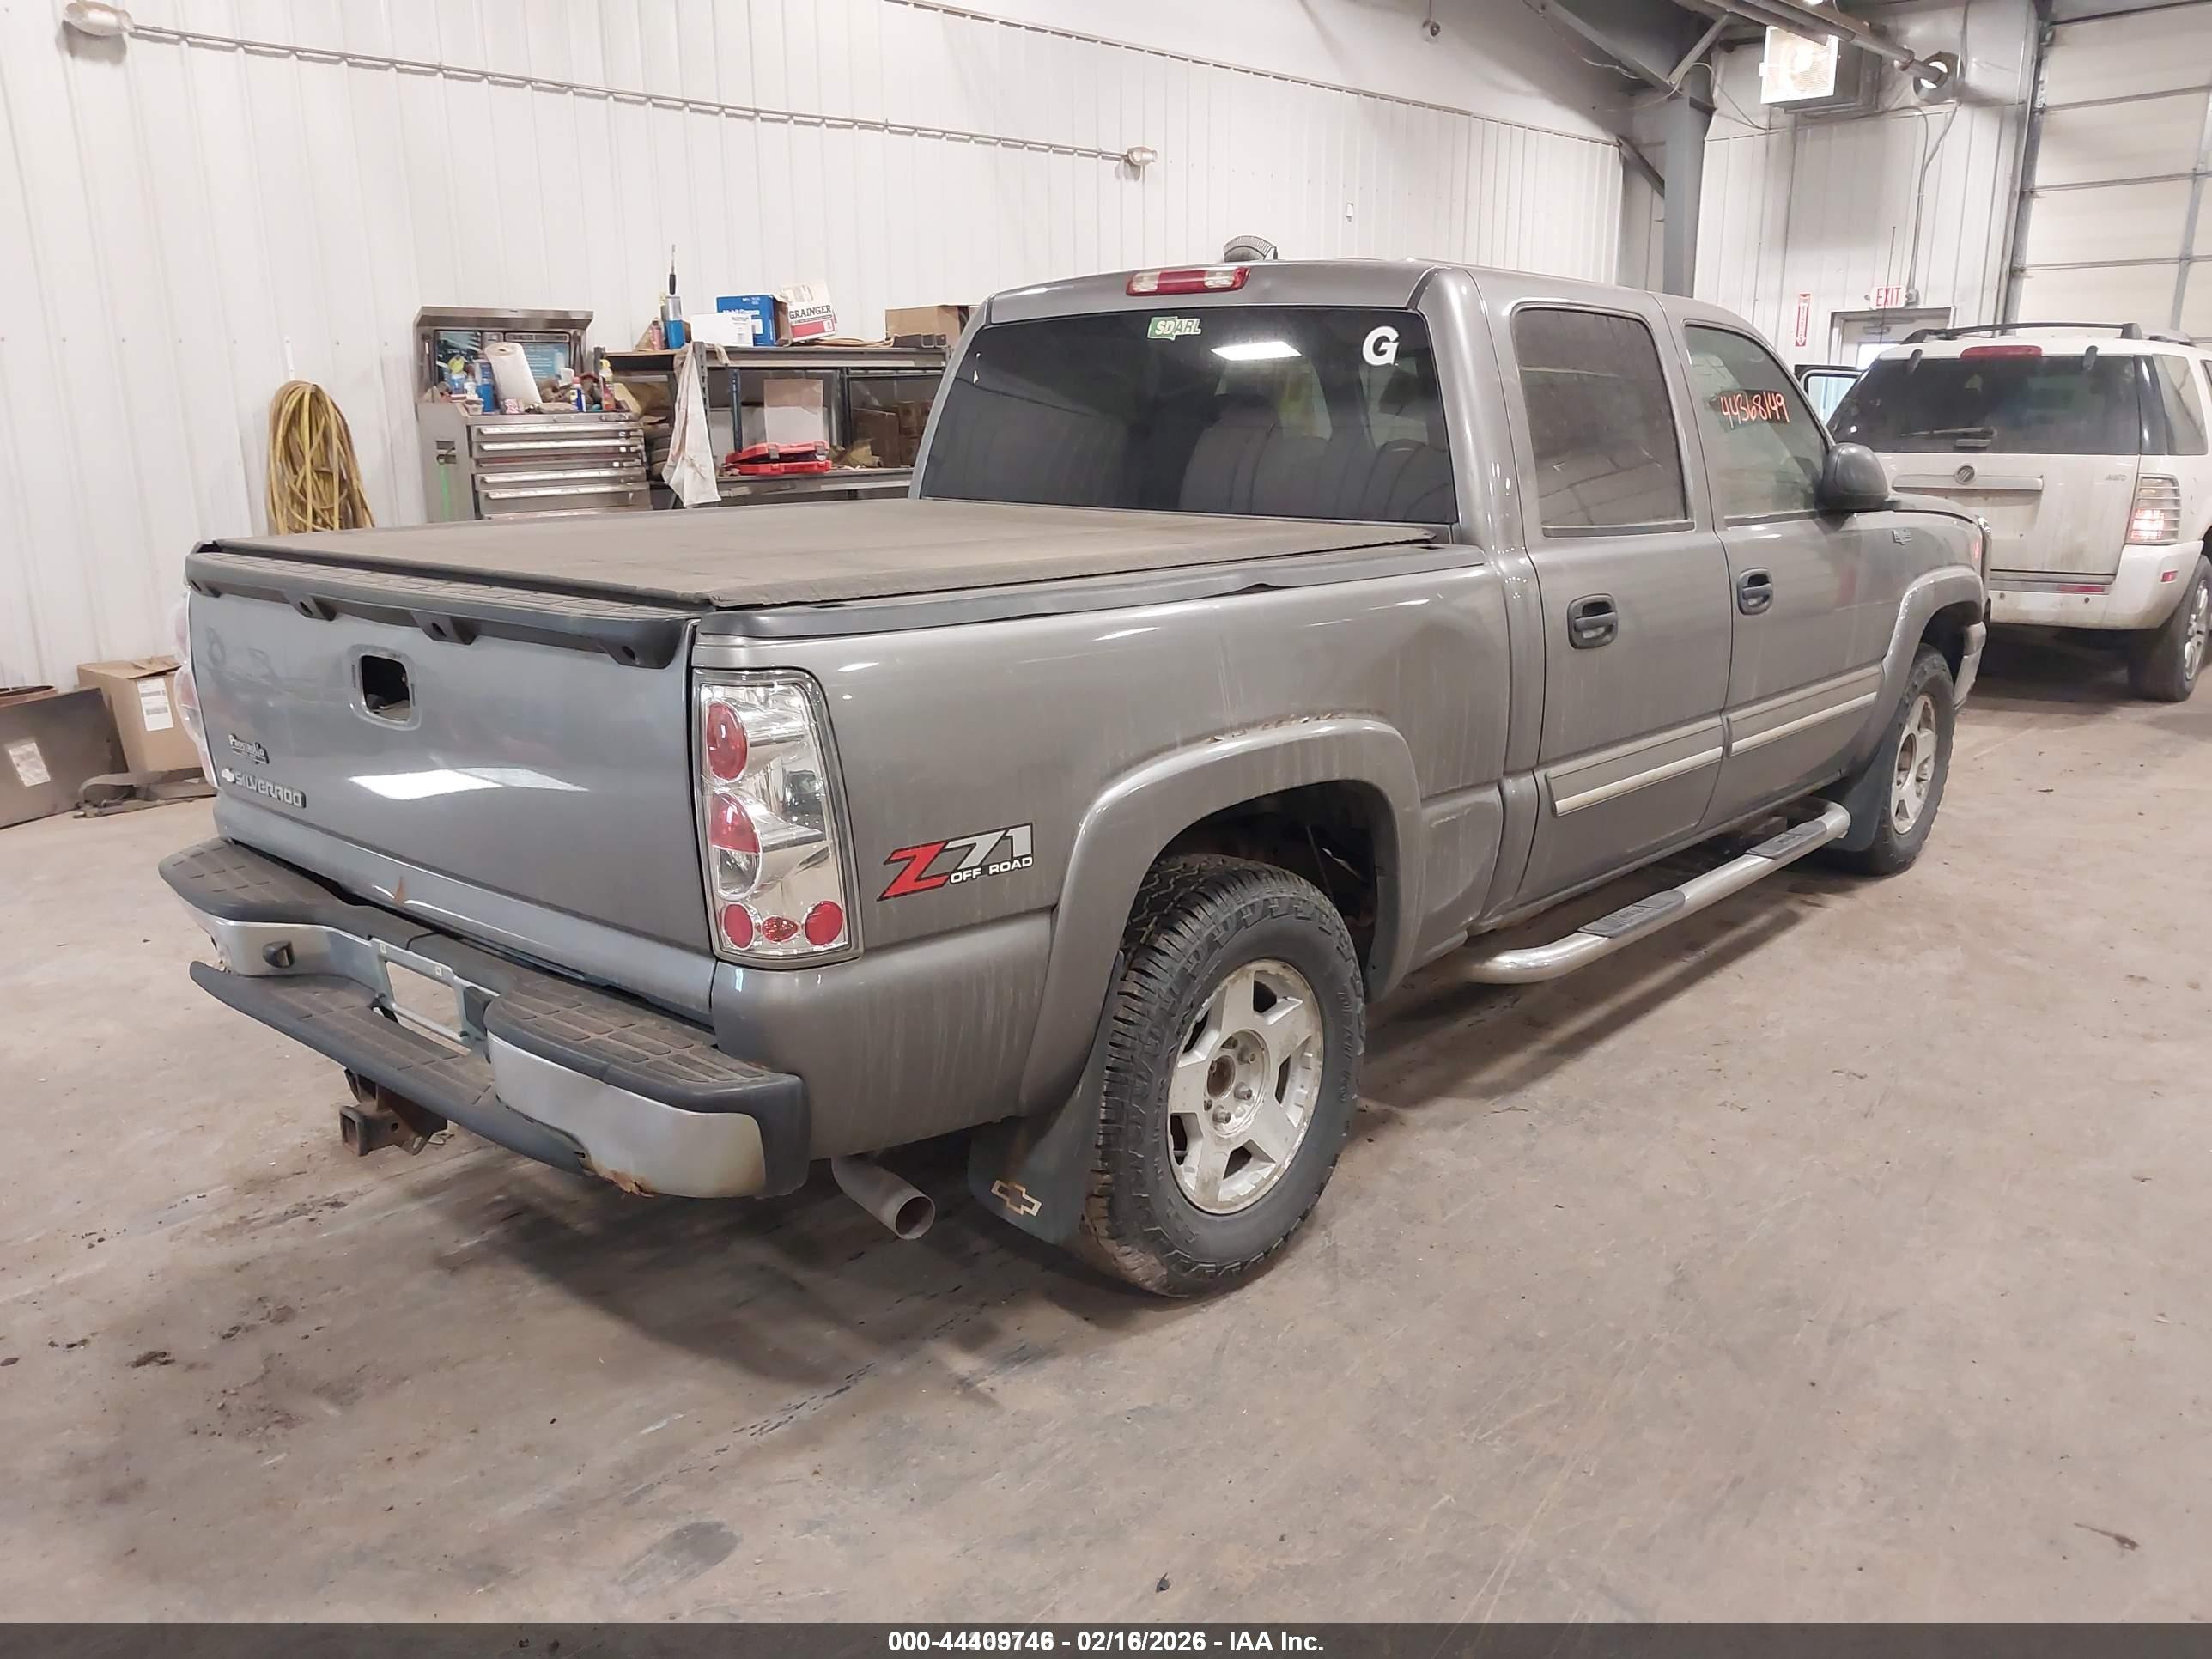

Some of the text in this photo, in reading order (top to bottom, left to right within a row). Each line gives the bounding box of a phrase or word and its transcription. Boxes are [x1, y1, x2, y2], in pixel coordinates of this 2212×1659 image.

[789, 304, 831, 319] GRAINGER
[1875, 287, 1901, 307] EXIT
[1155, 319, 1200, 335] SDARL
[1363, 325, 1400, 366] G
[1720, 391, 1790, 429] 44368149
[234, 772, 303, 808] SILVERADO
[876, 822, 1034, 902] Z71
[950, 855, 1034, 885] OFF ROAD
